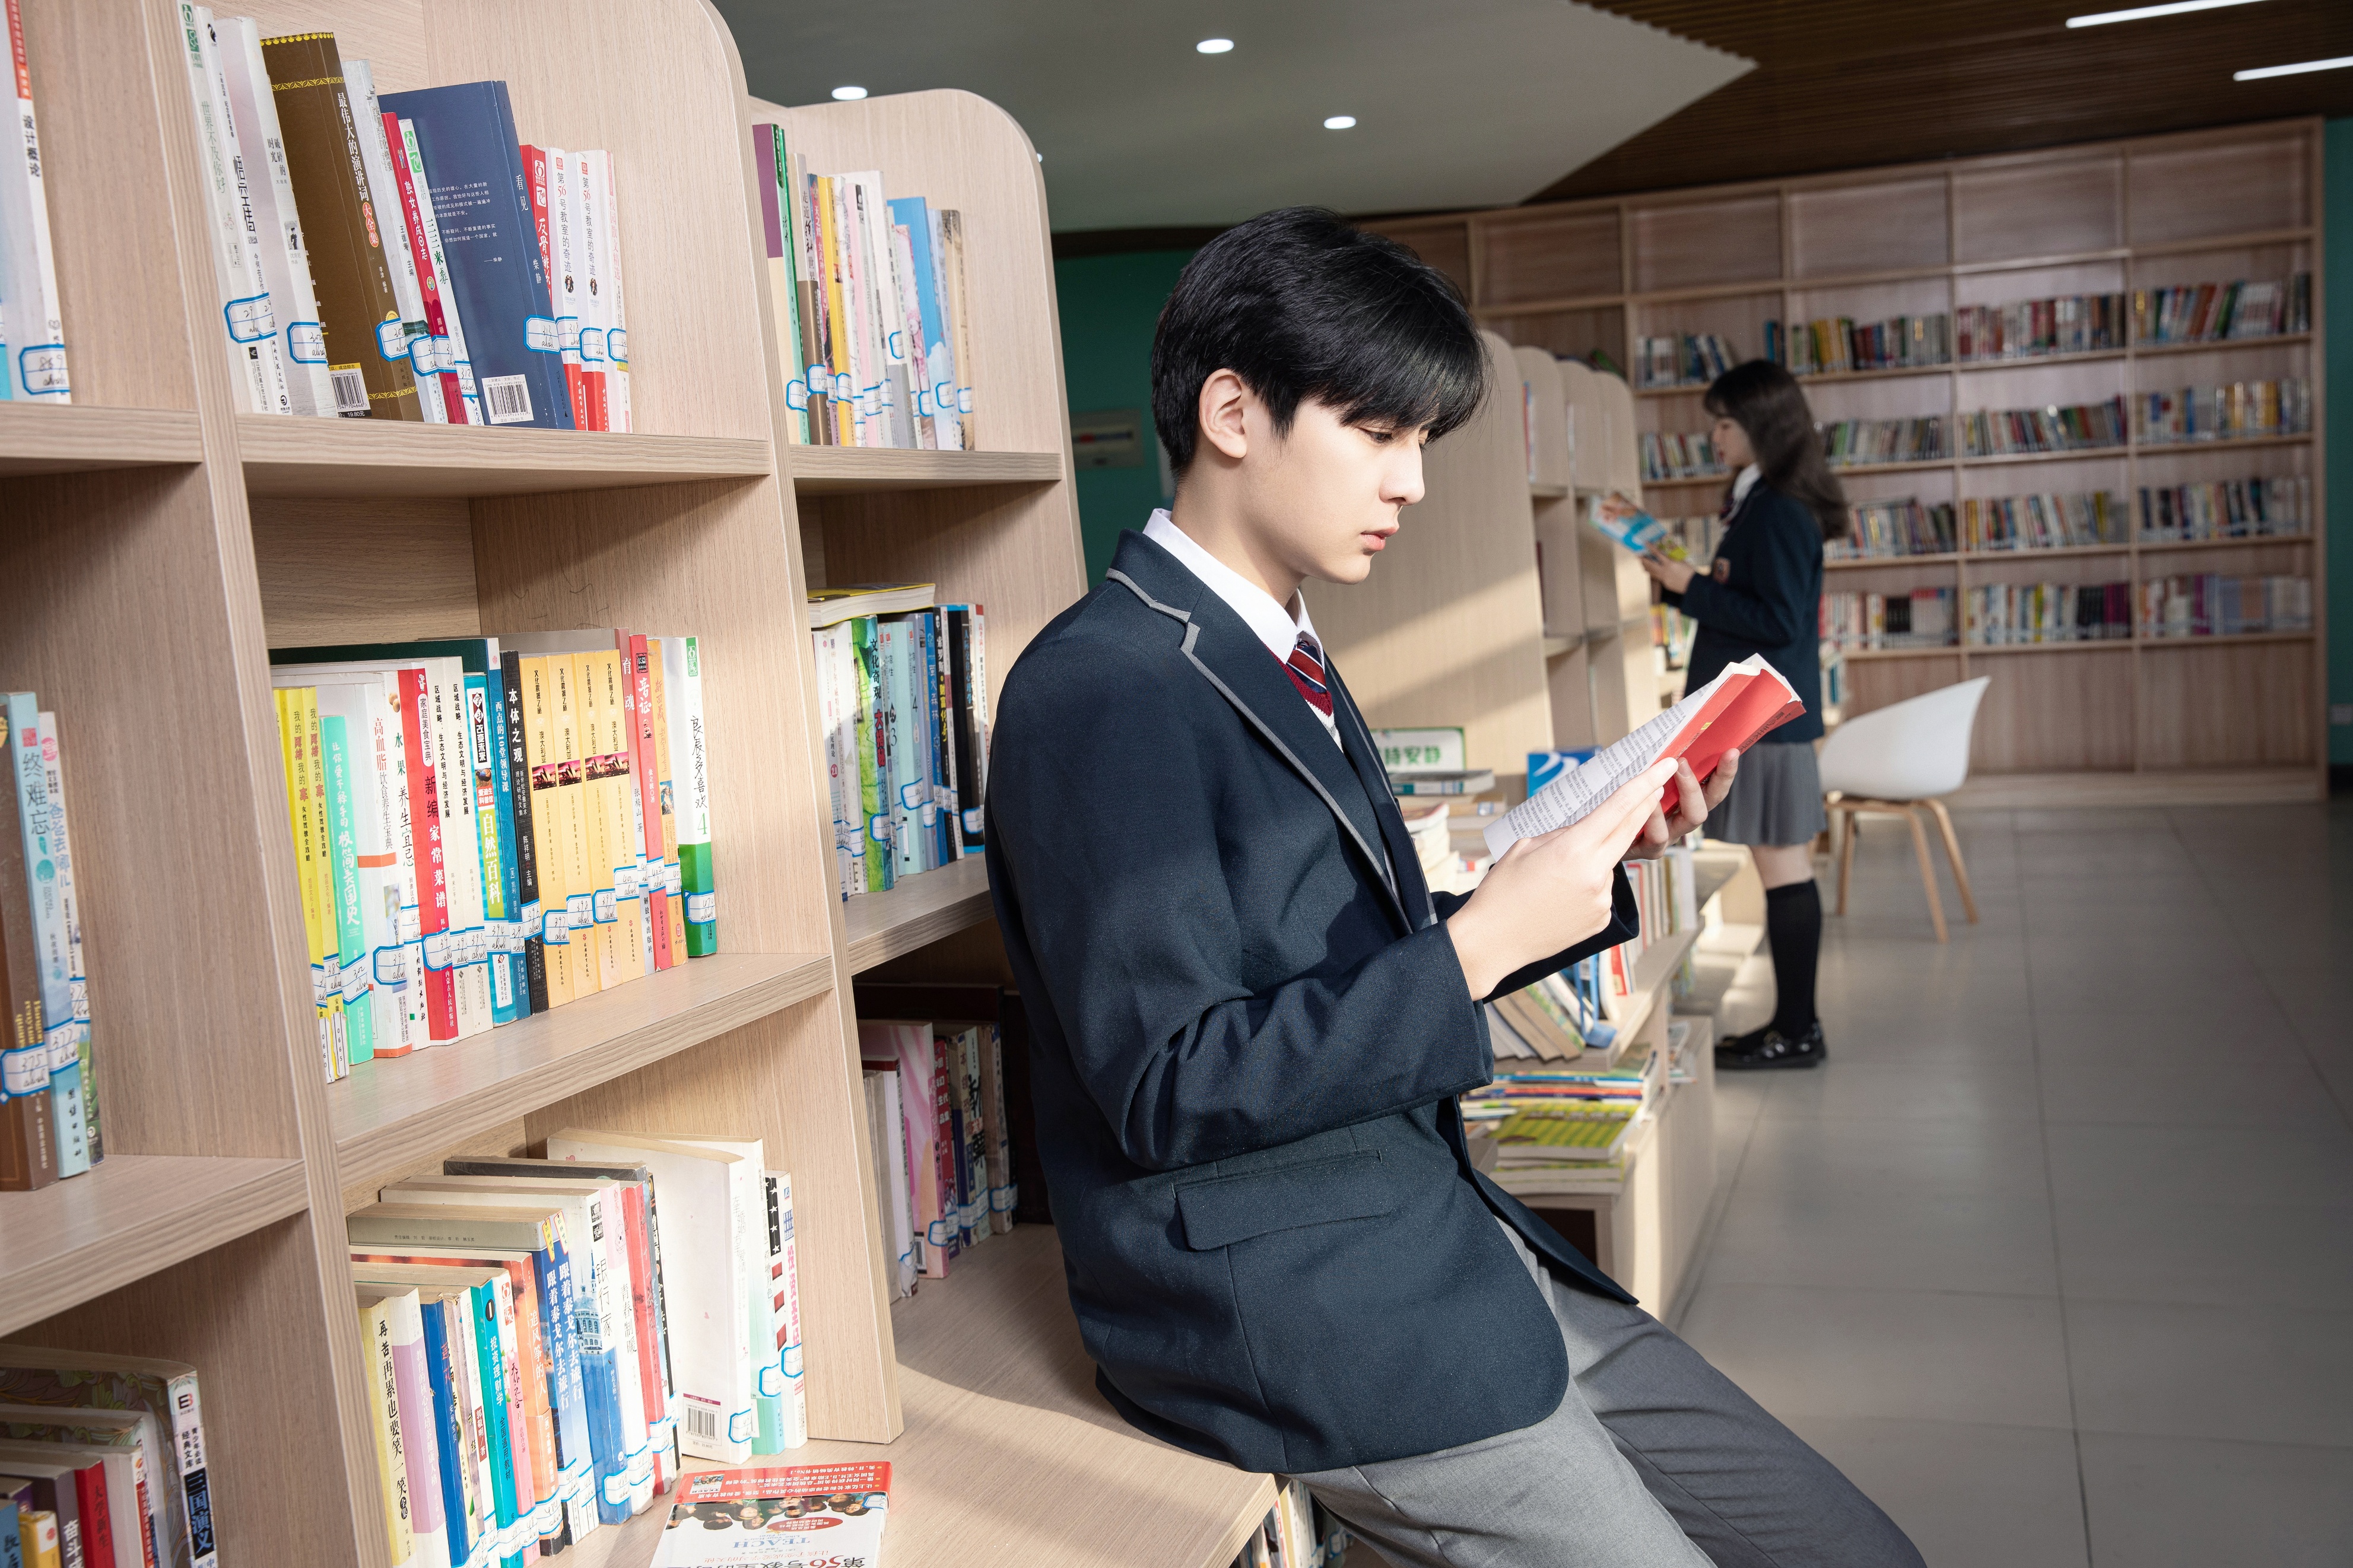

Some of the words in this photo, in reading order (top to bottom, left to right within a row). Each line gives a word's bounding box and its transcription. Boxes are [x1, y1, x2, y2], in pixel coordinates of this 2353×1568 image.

[201, 101, 226, 194] 世界不及你好
[337, 92, 370, 202] 最伟大的演讲词
[363, 203, 380, 246] 大全集
[515, 174, 529, 212] 看见
[557, 172, 573, 273] 第56号教室的奇迹
[582, 177, 596, 276] 第56号教室的奇迹
[870, 638, 882, 700] 文化奇观
[912, 695, 918, 713] 4
[420, 698, 431, 761] 家庭美食宝典
[472, 692, 488, 763] 学习改变未来
[495, 700, 509, 793] 西点的10堂领导课
[509, 688, 523, 763] 本体之观
[538, 731, 547, 764] 澳大利亚
[564, 728, 572, 760] 澳大利亚
[874, 708, 886, 768] 大揭秘
[890, 727, 897, 747] 3
[332, 742, 348, 828] 让你爱不释手的
[373, 717, 393, 851] 高血脂饮食养生宝典
[394, 732, 414, 867] 水果养生宜忌
[301, 806, 310, 861] 女性驾驶全攻略
[318, 802, 326, 857] 女性驾驶全攻略
[425, 775, 446, 908] 新编家常菜谱
[482, 813, 501, 905] 自然百科
[697, 812, 708, 835] 4
[338, 831, 360, 925] 极简美国史
[643, 897, 653, 954] 解放军出版社
[444, 969, 455, 1027] 内蒙古人民出版社
[595, 1258, 613, 1338] 银行家
[764, 1249, 774, 1299] 荷塘月色
[787, 1245, 800, 1347] 投资圣经
[529, 1309, 547, 1400] 追风筝的人
[547, 1270, 570, 1412] 跟着泰戈尔去旅行
[559, 1261, 582, 1402] 跟着泰戈尔去旅行
[621, 1281, 637, 1355] 青春制暖
[490, 1335, 504, 1407] 投资理财学
[379, 1319, 407, 1499] 再苦再累也要笑一笑
[181, 1430, 193, 1468] 经典文库
[499, 1416, 511, 1481] 全国通用教材
[186, 1472, 213, 1554] 三国演义
[733, 1537, 810, 1548] TEACH
